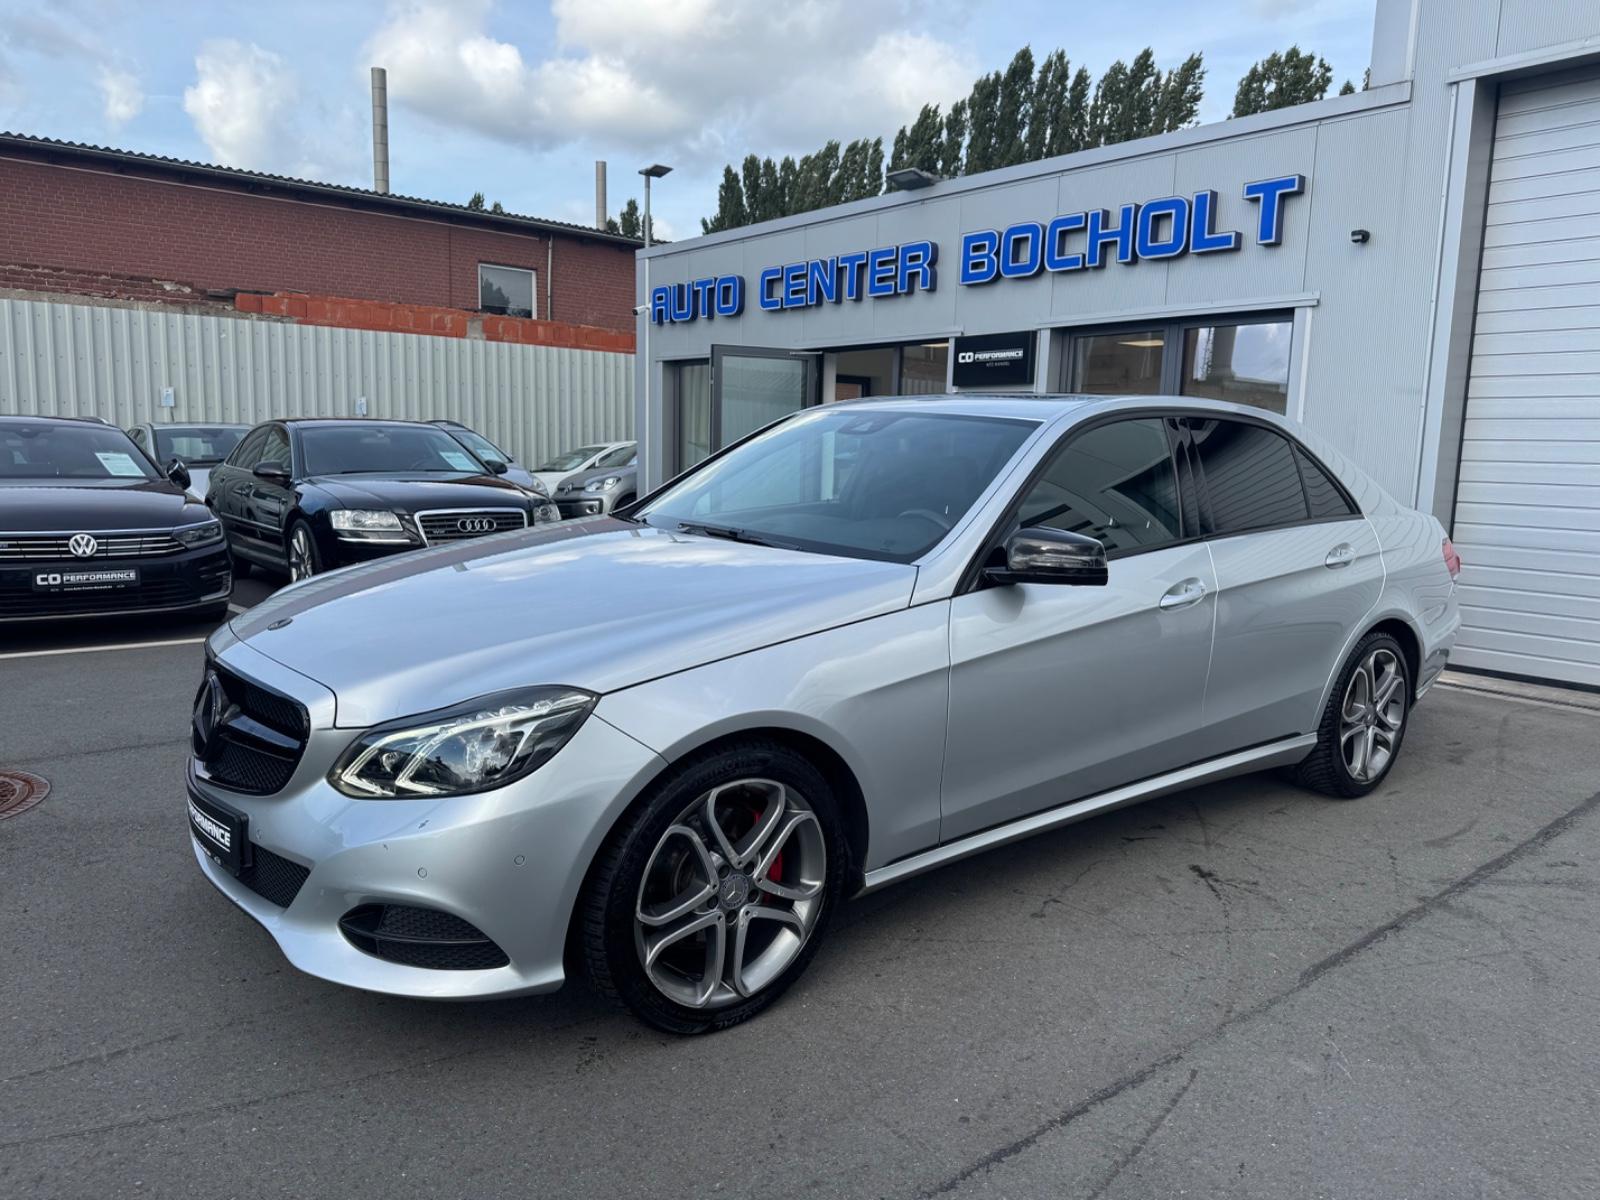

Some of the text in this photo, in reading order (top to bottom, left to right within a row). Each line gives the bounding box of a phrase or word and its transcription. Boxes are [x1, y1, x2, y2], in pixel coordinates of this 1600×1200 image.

[651, 275, 743, 324] AUTO
[760, 241, 936, 311] CENTER
[958, 352, 974, 363] CO
[36, 571, 136, 585] CO PERFORMANCE
